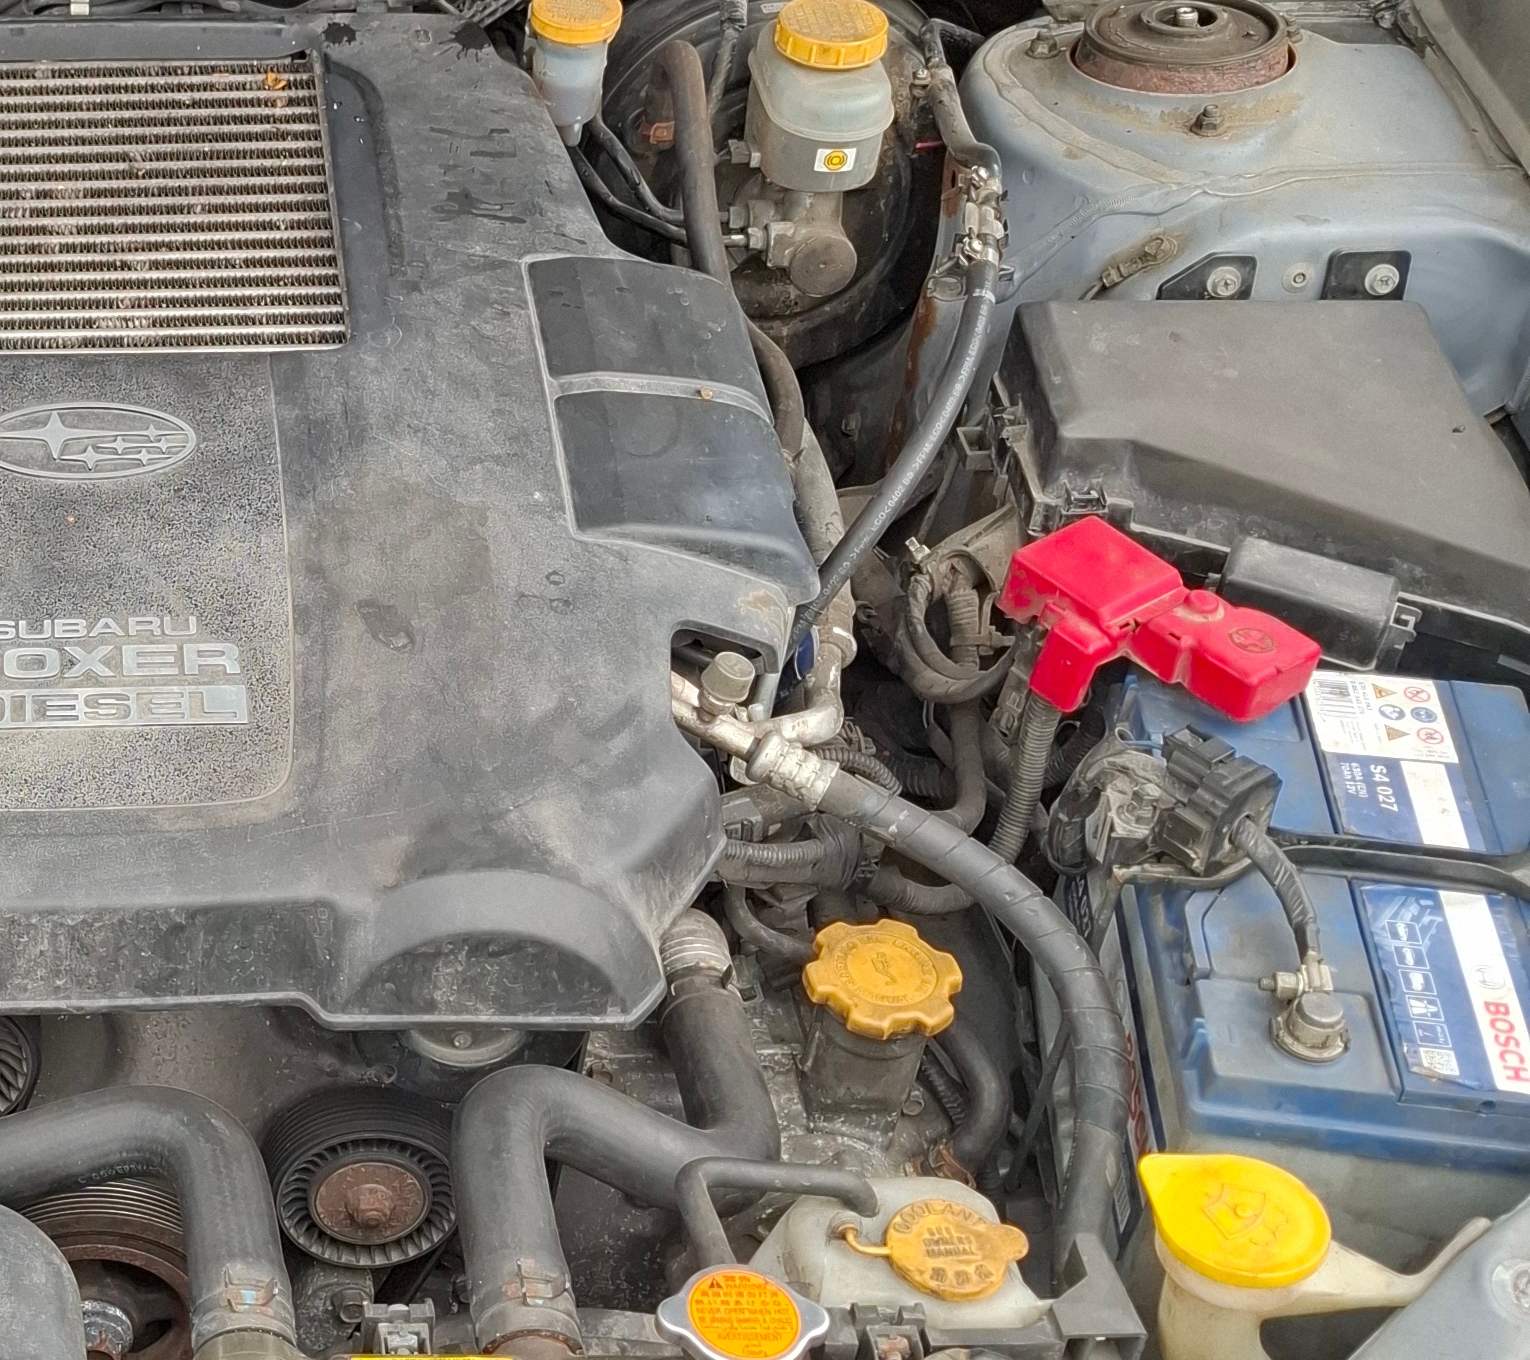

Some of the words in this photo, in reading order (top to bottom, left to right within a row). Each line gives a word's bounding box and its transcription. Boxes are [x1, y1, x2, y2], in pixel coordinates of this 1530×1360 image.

[1370, 764, 1389, 782] S4
[1376, 786, 1398, 812] 027
[1483, 1000, 1530, 1083] BOSCH
[893, 1201, 988, 1234] COOLANT
